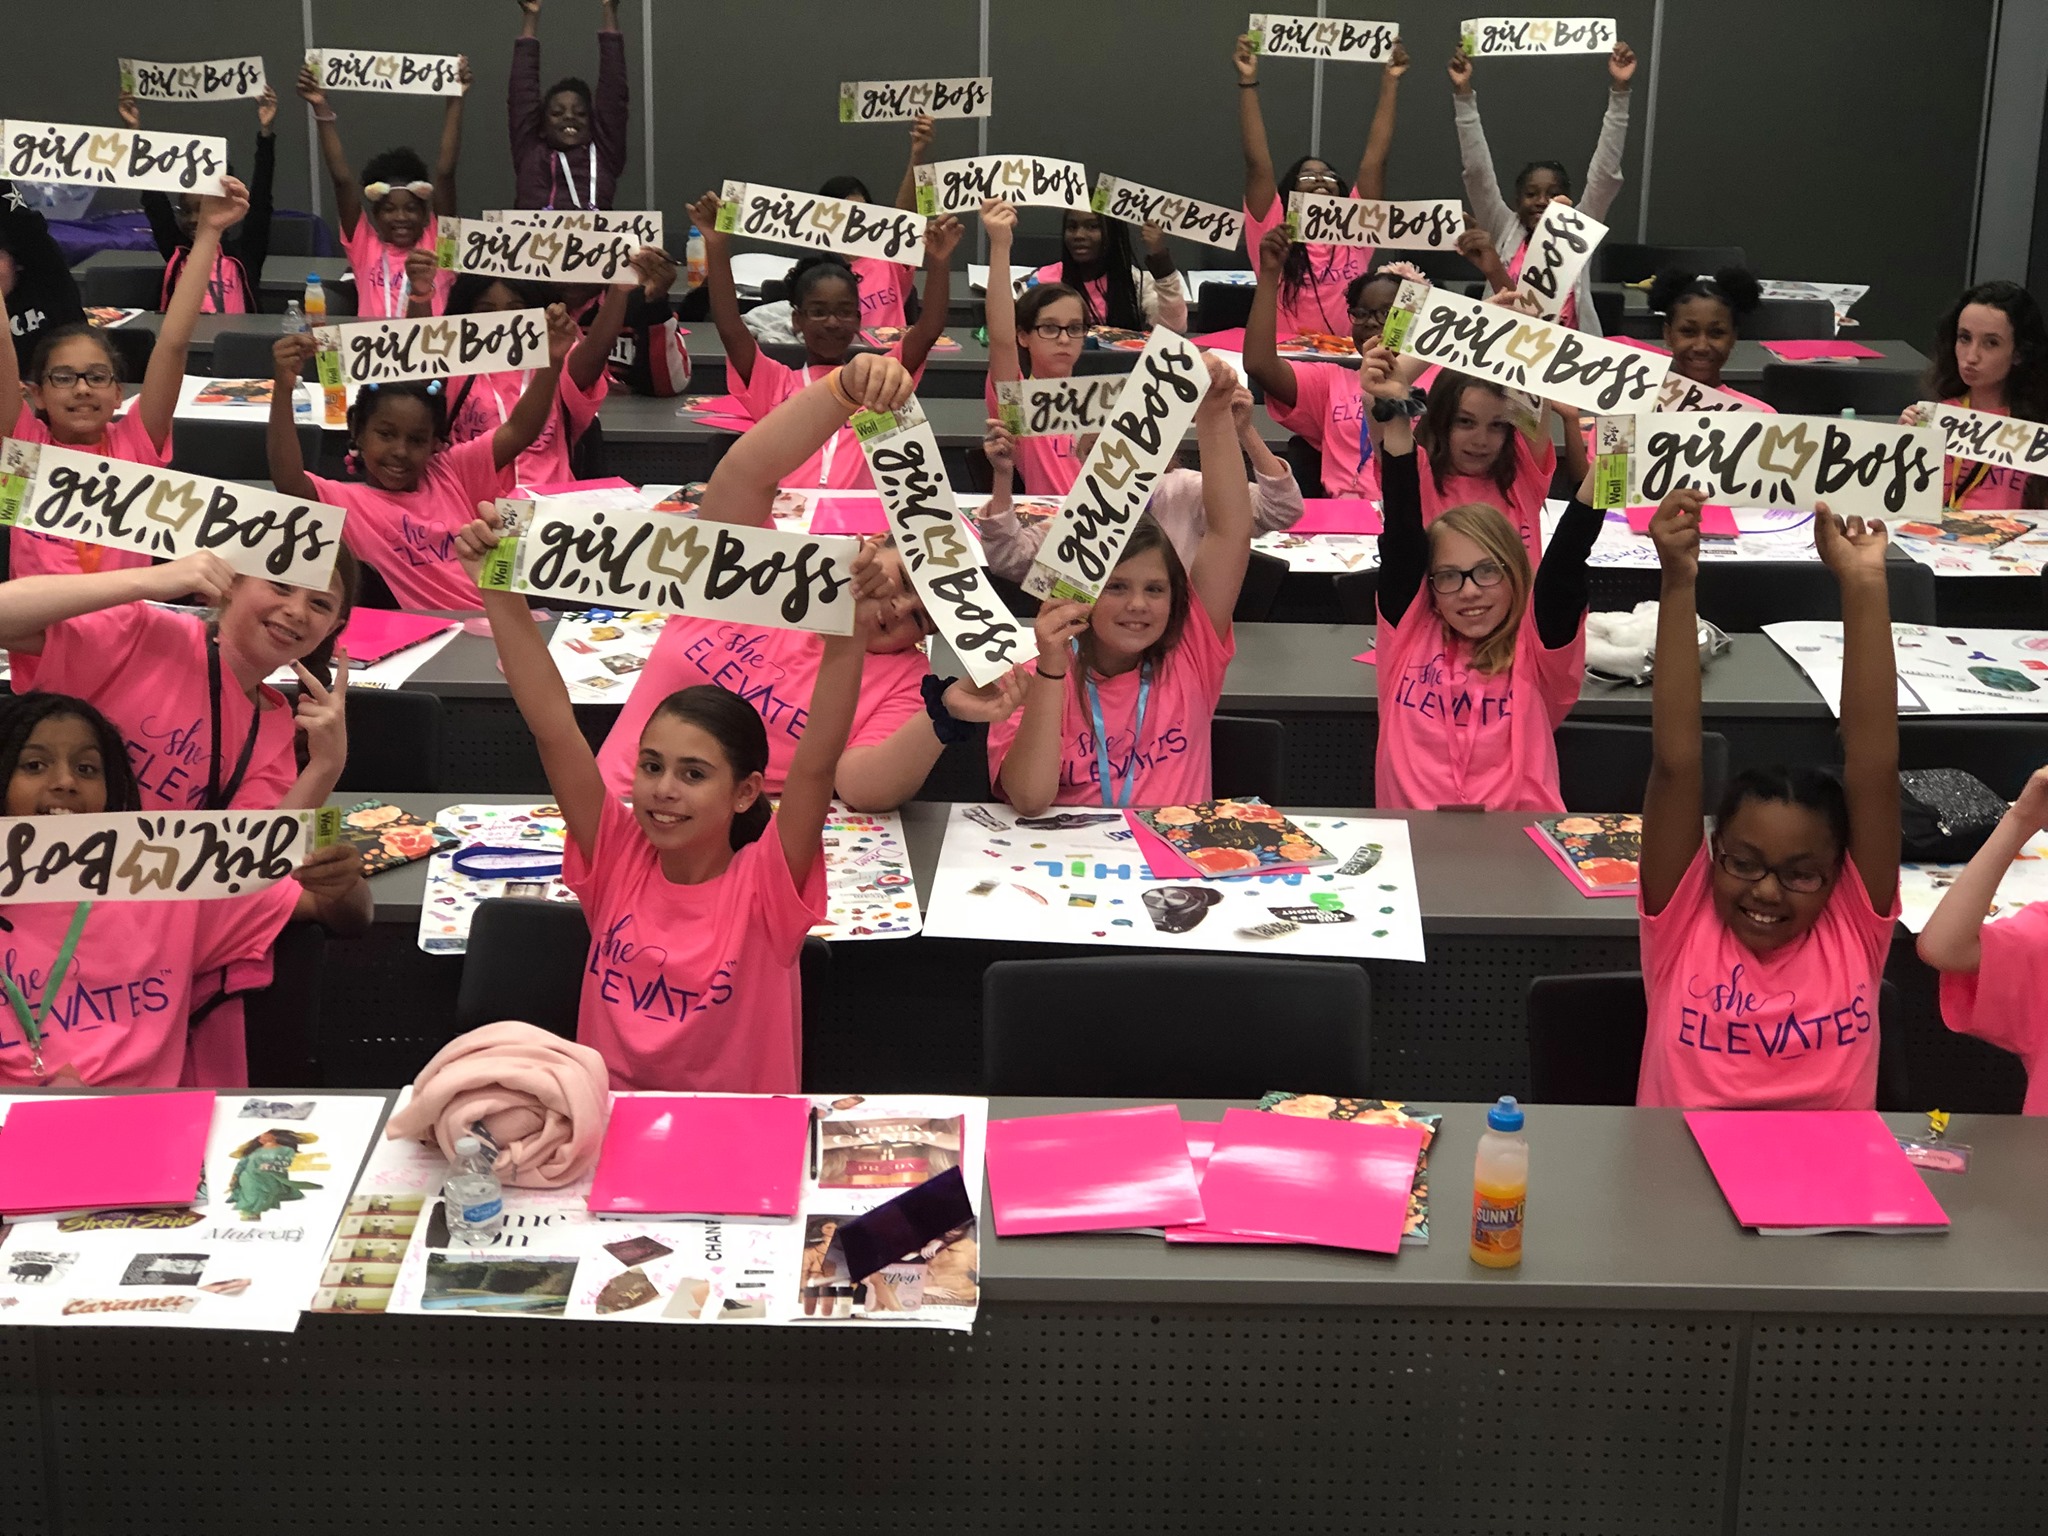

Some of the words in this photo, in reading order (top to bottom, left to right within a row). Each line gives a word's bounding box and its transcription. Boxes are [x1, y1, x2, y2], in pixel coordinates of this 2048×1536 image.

[1268, 19, 1318, 53] girl
[1340, 22, 1393, 59] Boss
[1481, 20, 1531, 53] girl
[1554, 20, 1613, 51] Boss
[138, 65, 177, 97] girl
[203, 61, 262, 95] Boss
[326, 53, 376, 87] girl
[399, 56, 457, 92] Boss
[861, 83, 911, 119] girl
[932, 81, 990, 114] Boss
[9, 126, 91, 177] girl
[127, 133, 223, 189] Boss
[943, 161, 1002, 210] girl
[1032, 159, 1086, 205] Boss
[744, 193, 816, 238] girl
[842, 205, 924, 258] Boss
[1111, 187, 1165, 222] girl
[1181, 201, 1240, 242] Boss
[1304, 199, 1359, 240] girl
[1388, 203, 1463, 247] Boss
[462, 226, 532, 271] girl
[561, 233, 632, 280] Boss
[1522, 211, 1588, 298] Boss
[350, 324, 420, 381] girl
[459, 314, 545, 367] Boss
[1414, 305, 1518, 368] girl
[1543, 333, 1658, 410] Boss
[1030, 381, 1101, 433] girl
[1112, 341, 1199, 456] Boss
[857, 419, 878, 436] Wall
[1940, 413, 2003, 455] girl
[872, 440, 953, 529] girl
[1641, 416, 1763, 501] girl
[1814, 424, 1940, 513] Boss
[35, 461, 155, 538] girl
[194, 485, 335, 576] Boss
[1608, 479, 1621, 505] Wall
[1057, 474, 1130, 582] girl
[495, 560, 508, 586] Wall
[529, 512, 655, 594] girl
[703, 529, 852, 624] Boss
[929, 566, 1017, 665] Boss
[720, 628, 773, 674] she
[684, 637, 810, 740] ELEVATE
[1396, 677, 1514, 726] ELEVATE
[319, 811, 334, 836] Wall
[176, 814, 300, 894] girl
[1701, 963, 1777, 1018] she
[1678, 996, 1871, 1060] ELEVATES
[63, 1214, 131, 1232] Street
[132, 1211, 197, 1229] Style
